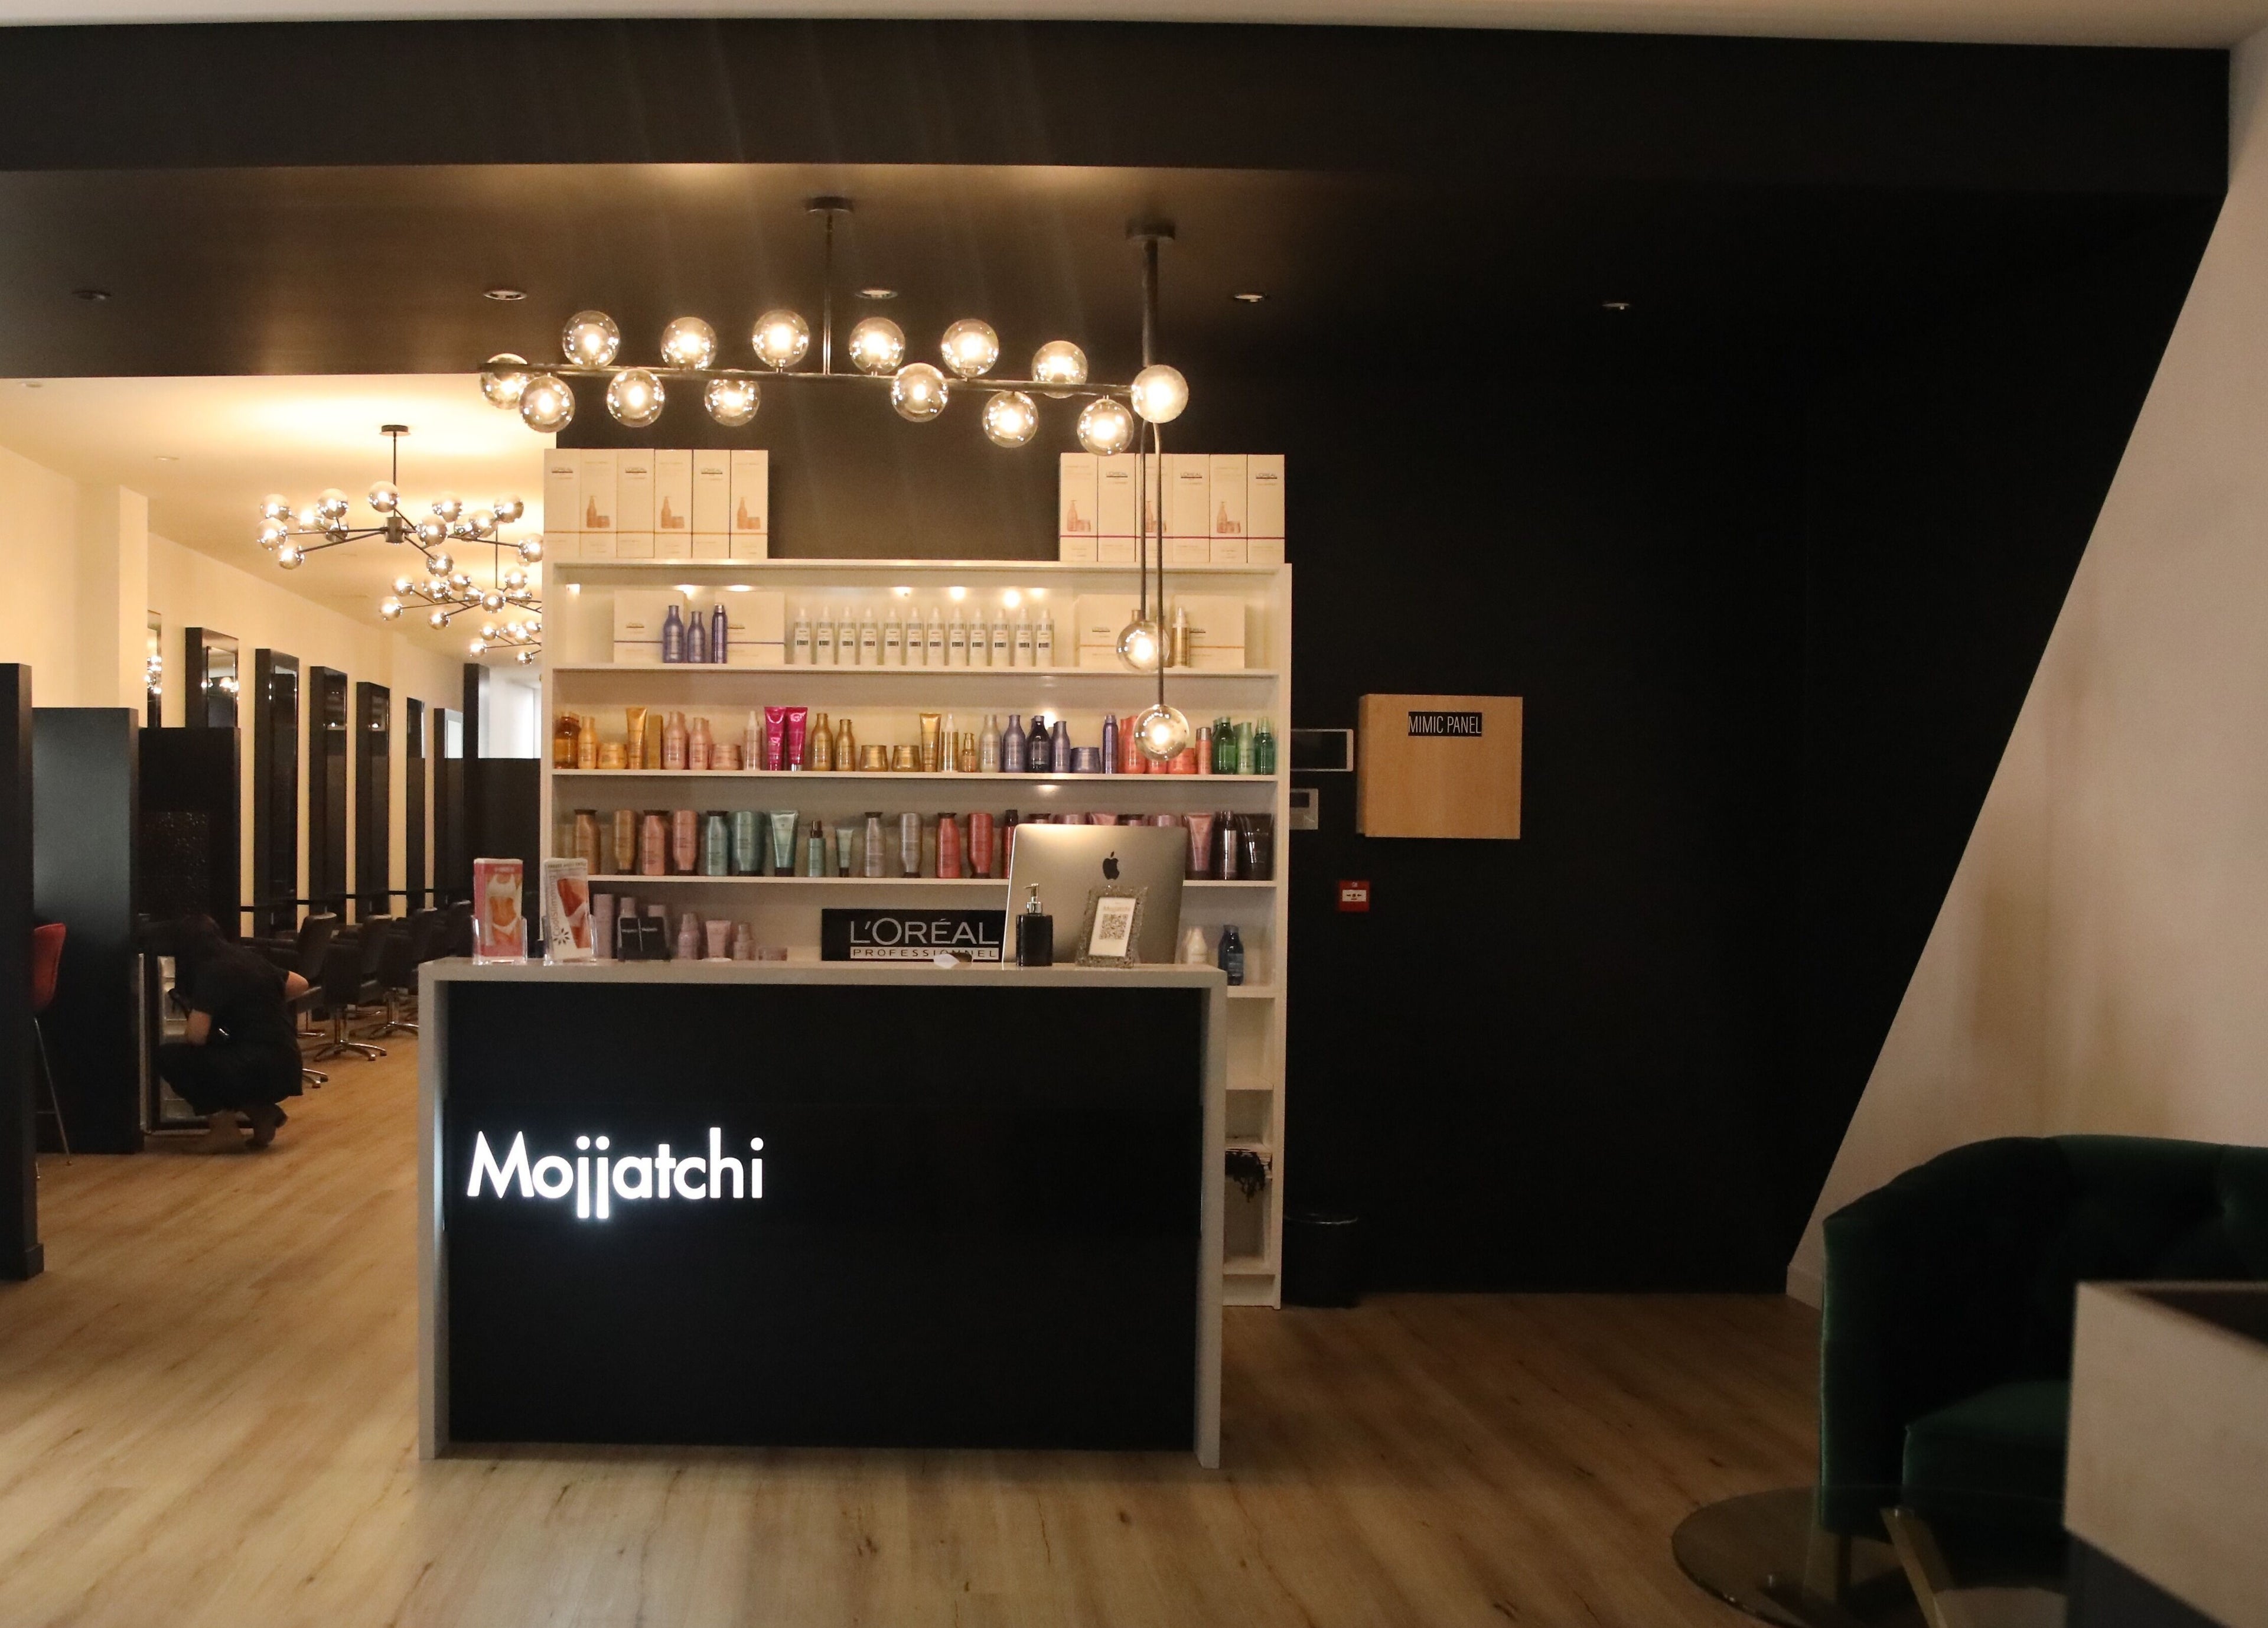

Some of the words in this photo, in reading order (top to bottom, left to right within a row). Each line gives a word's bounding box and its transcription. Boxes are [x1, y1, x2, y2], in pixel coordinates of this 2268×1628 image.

[1409, 715, 1443, 733] MIMIC
[1447, 716, 1482, 734] PANEL
[850, 917, 999, 945] L'ORÉAL
[467, 1127, 765, 1219] Mojjatchi
